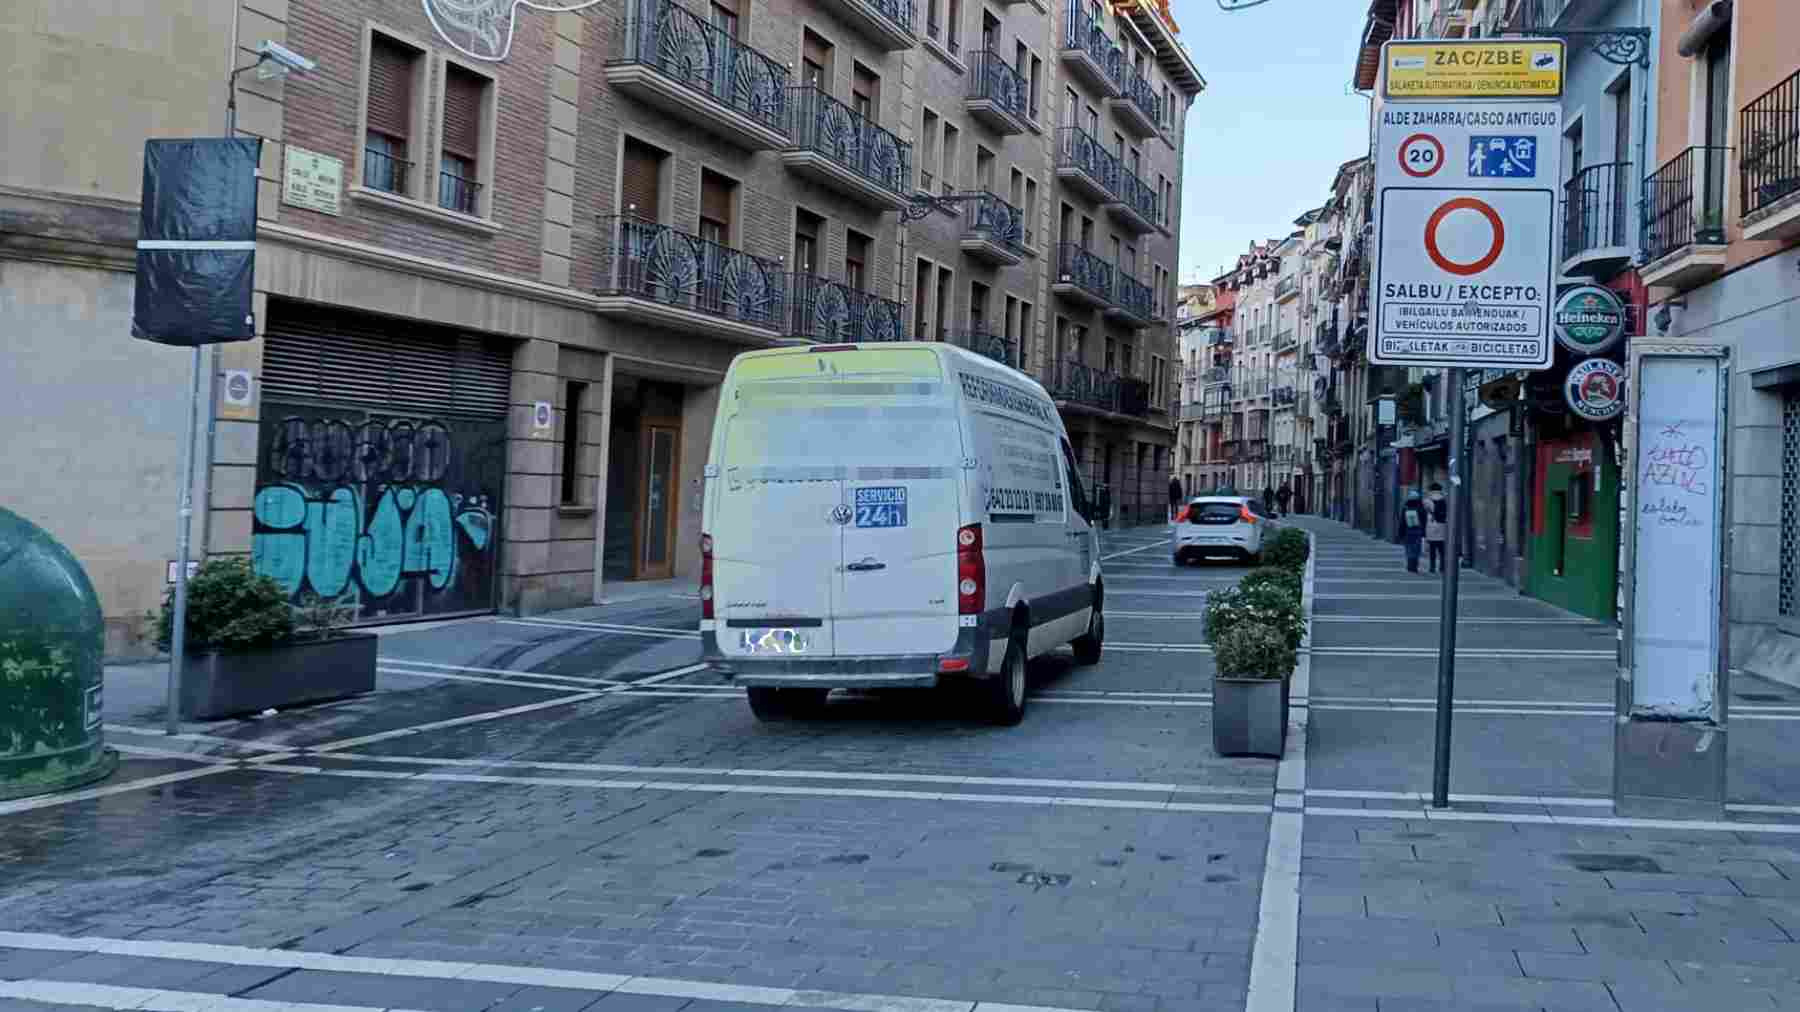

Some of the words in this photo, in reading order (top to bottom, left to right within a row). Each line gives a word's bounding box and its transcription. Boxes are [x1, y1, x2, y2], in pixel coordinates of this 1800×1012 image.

[1434, 50, 1523, 67] ZAC/ZBE
[1384, 111, 1410, 126] ALDE
[1411, 111, 1504, 127] ZAHARRA/CASCO
[1506, 112, 1557, 126] ANTIGUO
[1409, 149, 1434, 163] 20
[1385, 283, 1442, 299] SALBU
[1458, 285, 1542, 301] EXCEPTO:
[1559, 312, 1618, 324] Heineken
[1395, 319, 1453, 330] VEHÍCULOS
[1455, 321, 1528, 332] AUTORIZADOS
[1471, 343, 1537, 354] BICICLETAS
[857, 488, 905, 502] SERVICIO
